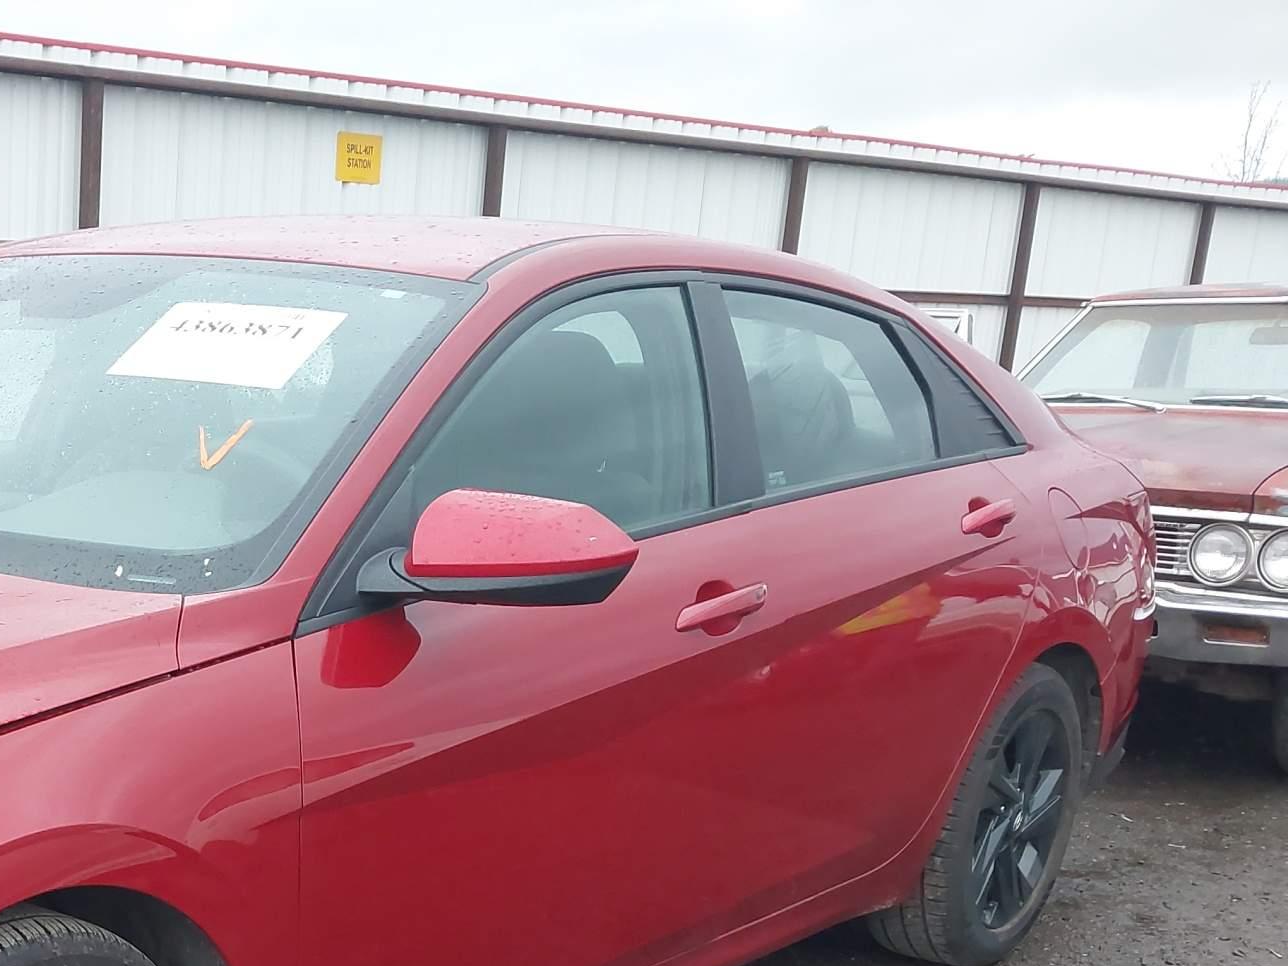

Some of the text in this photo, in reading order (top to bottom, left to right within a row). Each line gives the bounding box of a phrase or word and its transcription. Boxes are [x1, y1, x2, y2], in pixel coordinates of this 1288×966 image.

[346, 143, 374, 156] SPILL-KIT
[347, 157, 372, 169] STATION
[169, 319, 304, 339] 43863871
